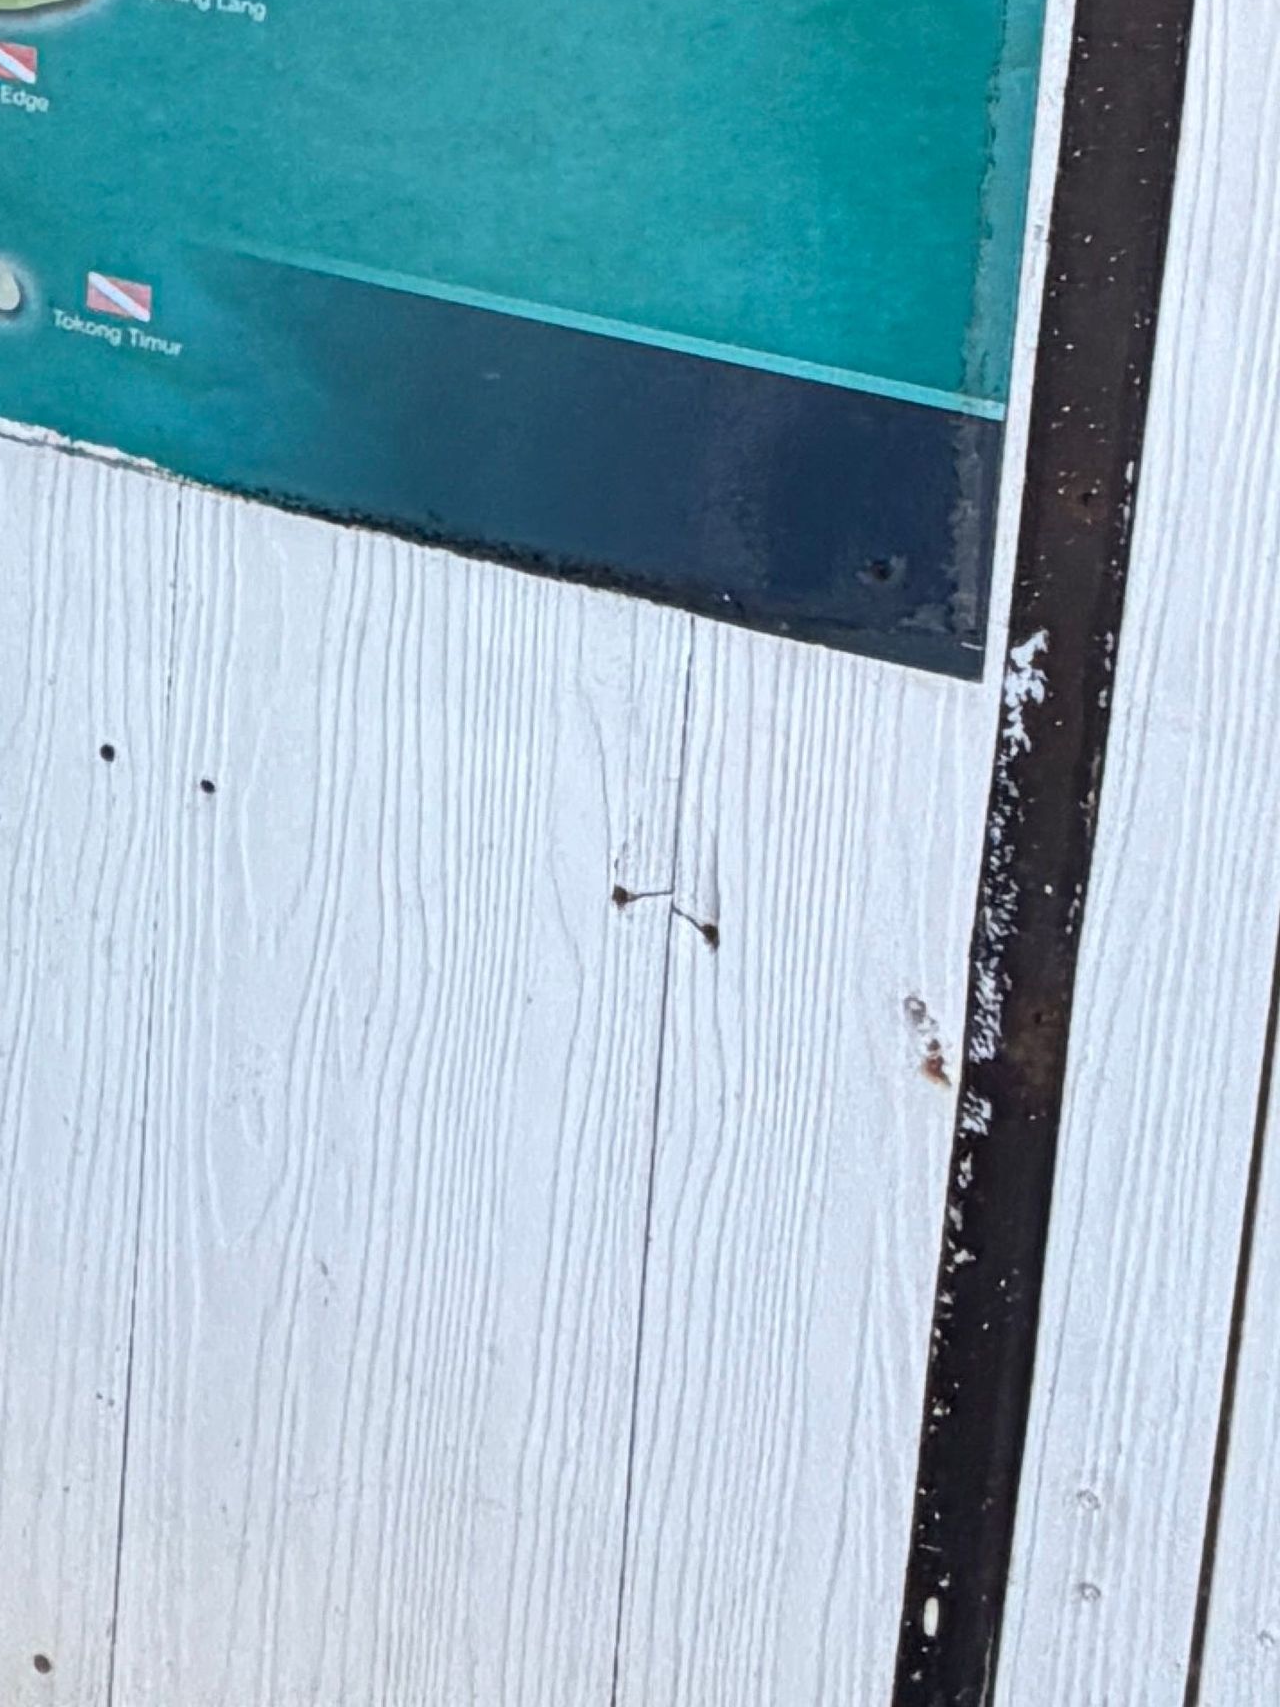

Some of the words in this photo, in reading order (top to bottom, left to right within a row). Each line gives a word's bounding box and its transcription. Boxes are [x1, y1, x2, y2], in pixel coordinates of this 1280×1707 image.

[0, 83, 50, 113] Edge
[51, 308, 122, 348] Tokong
[126, 325, 183, 358] Timur
